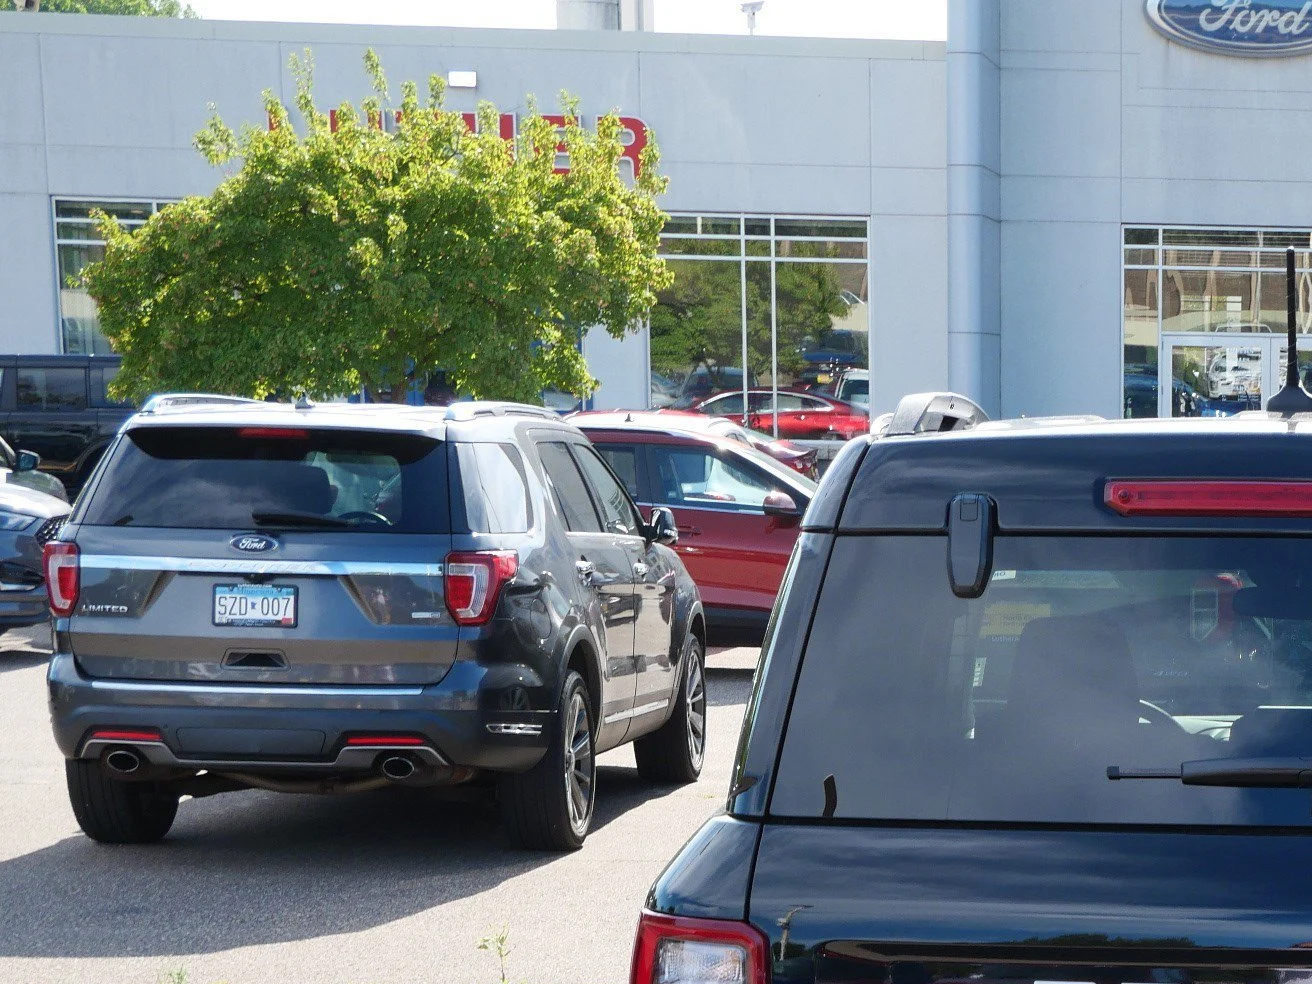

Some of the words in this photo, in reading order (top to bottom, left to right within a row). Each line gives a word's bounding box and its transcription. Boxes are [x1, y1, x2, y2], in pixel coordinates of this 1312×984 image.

[1200, 0, 1312, 35] Ford
[239, 537, 266, 550] Ford
[82, 604, 128, 614] LIMITED
[218, 596, 248, 616] SZD
[260, 596, 291, 617] 007
